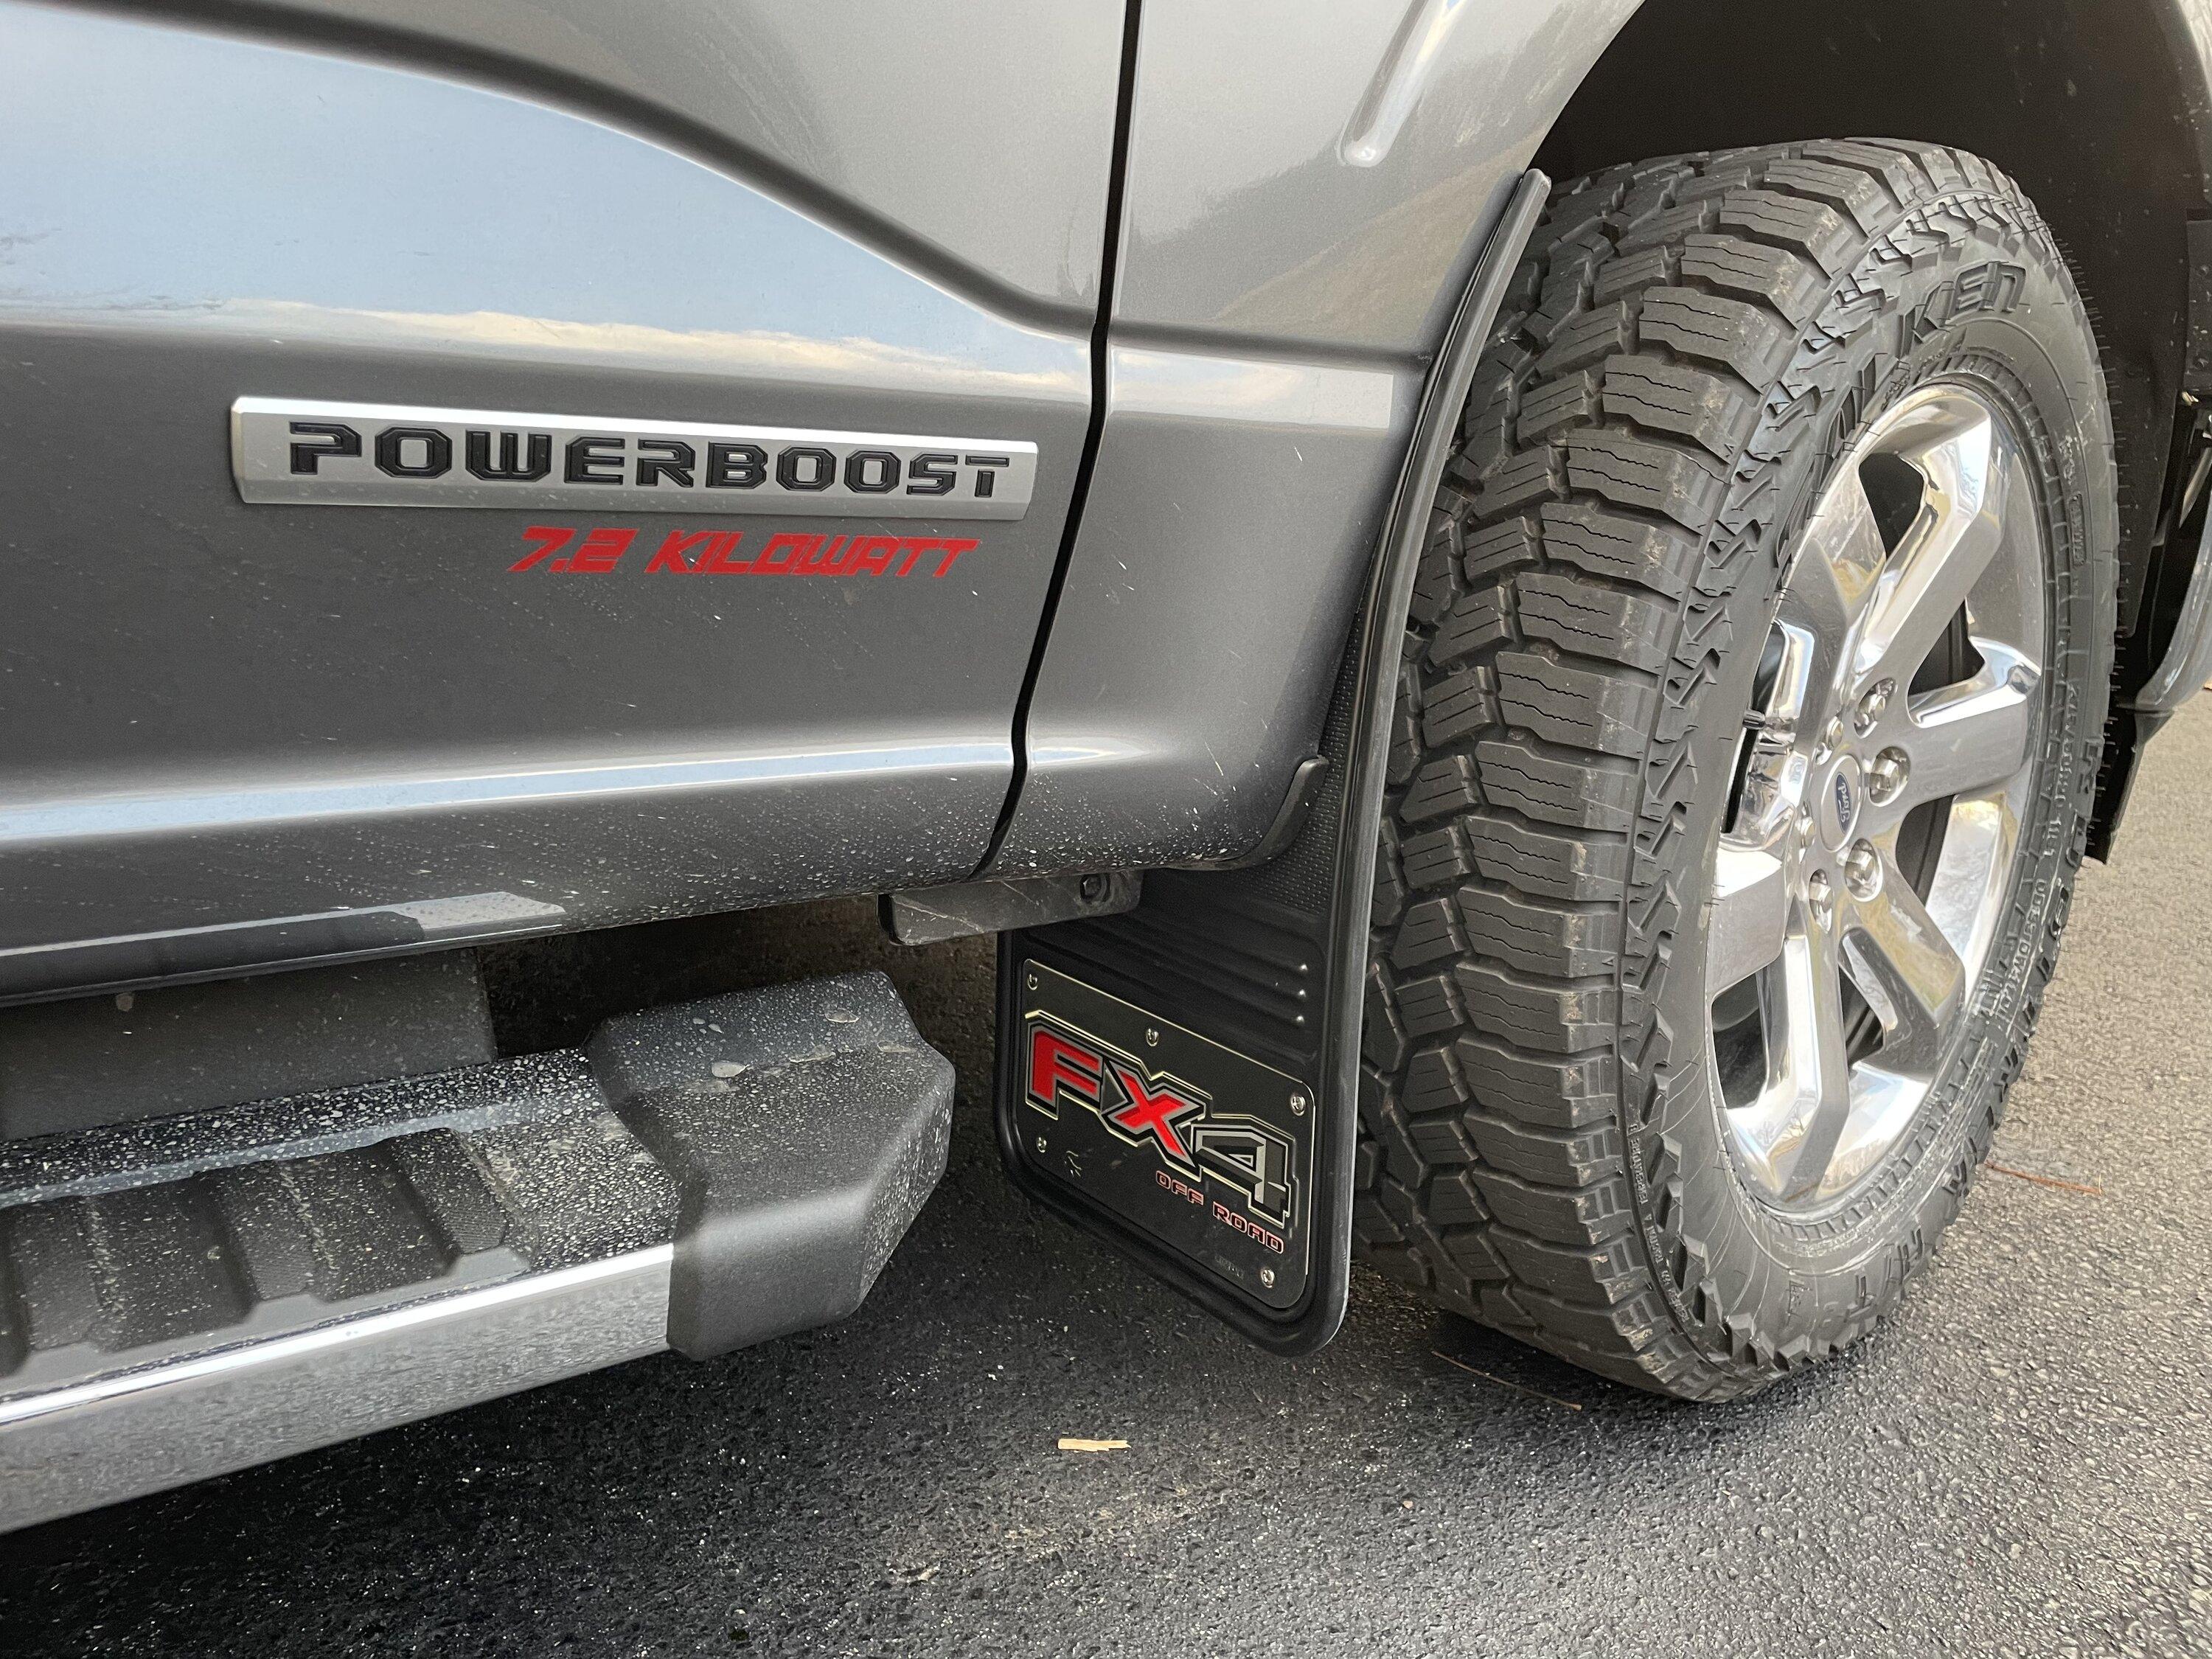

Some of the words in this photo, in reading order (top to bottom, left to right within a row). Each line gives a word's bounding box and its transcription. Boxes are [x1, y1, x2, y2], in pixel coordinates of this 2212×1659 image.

[289, 421, 1010, 498] POWERBOOST
[508, 525, 639, 574] 7.2
[644, 529, 981, 577] KILOWATT
[1026, 1018, 1292, 1227] FX4
[1155, 1170, 1204, 1206] OFF
[1212, 1200, 1284, 1254] ROAD
